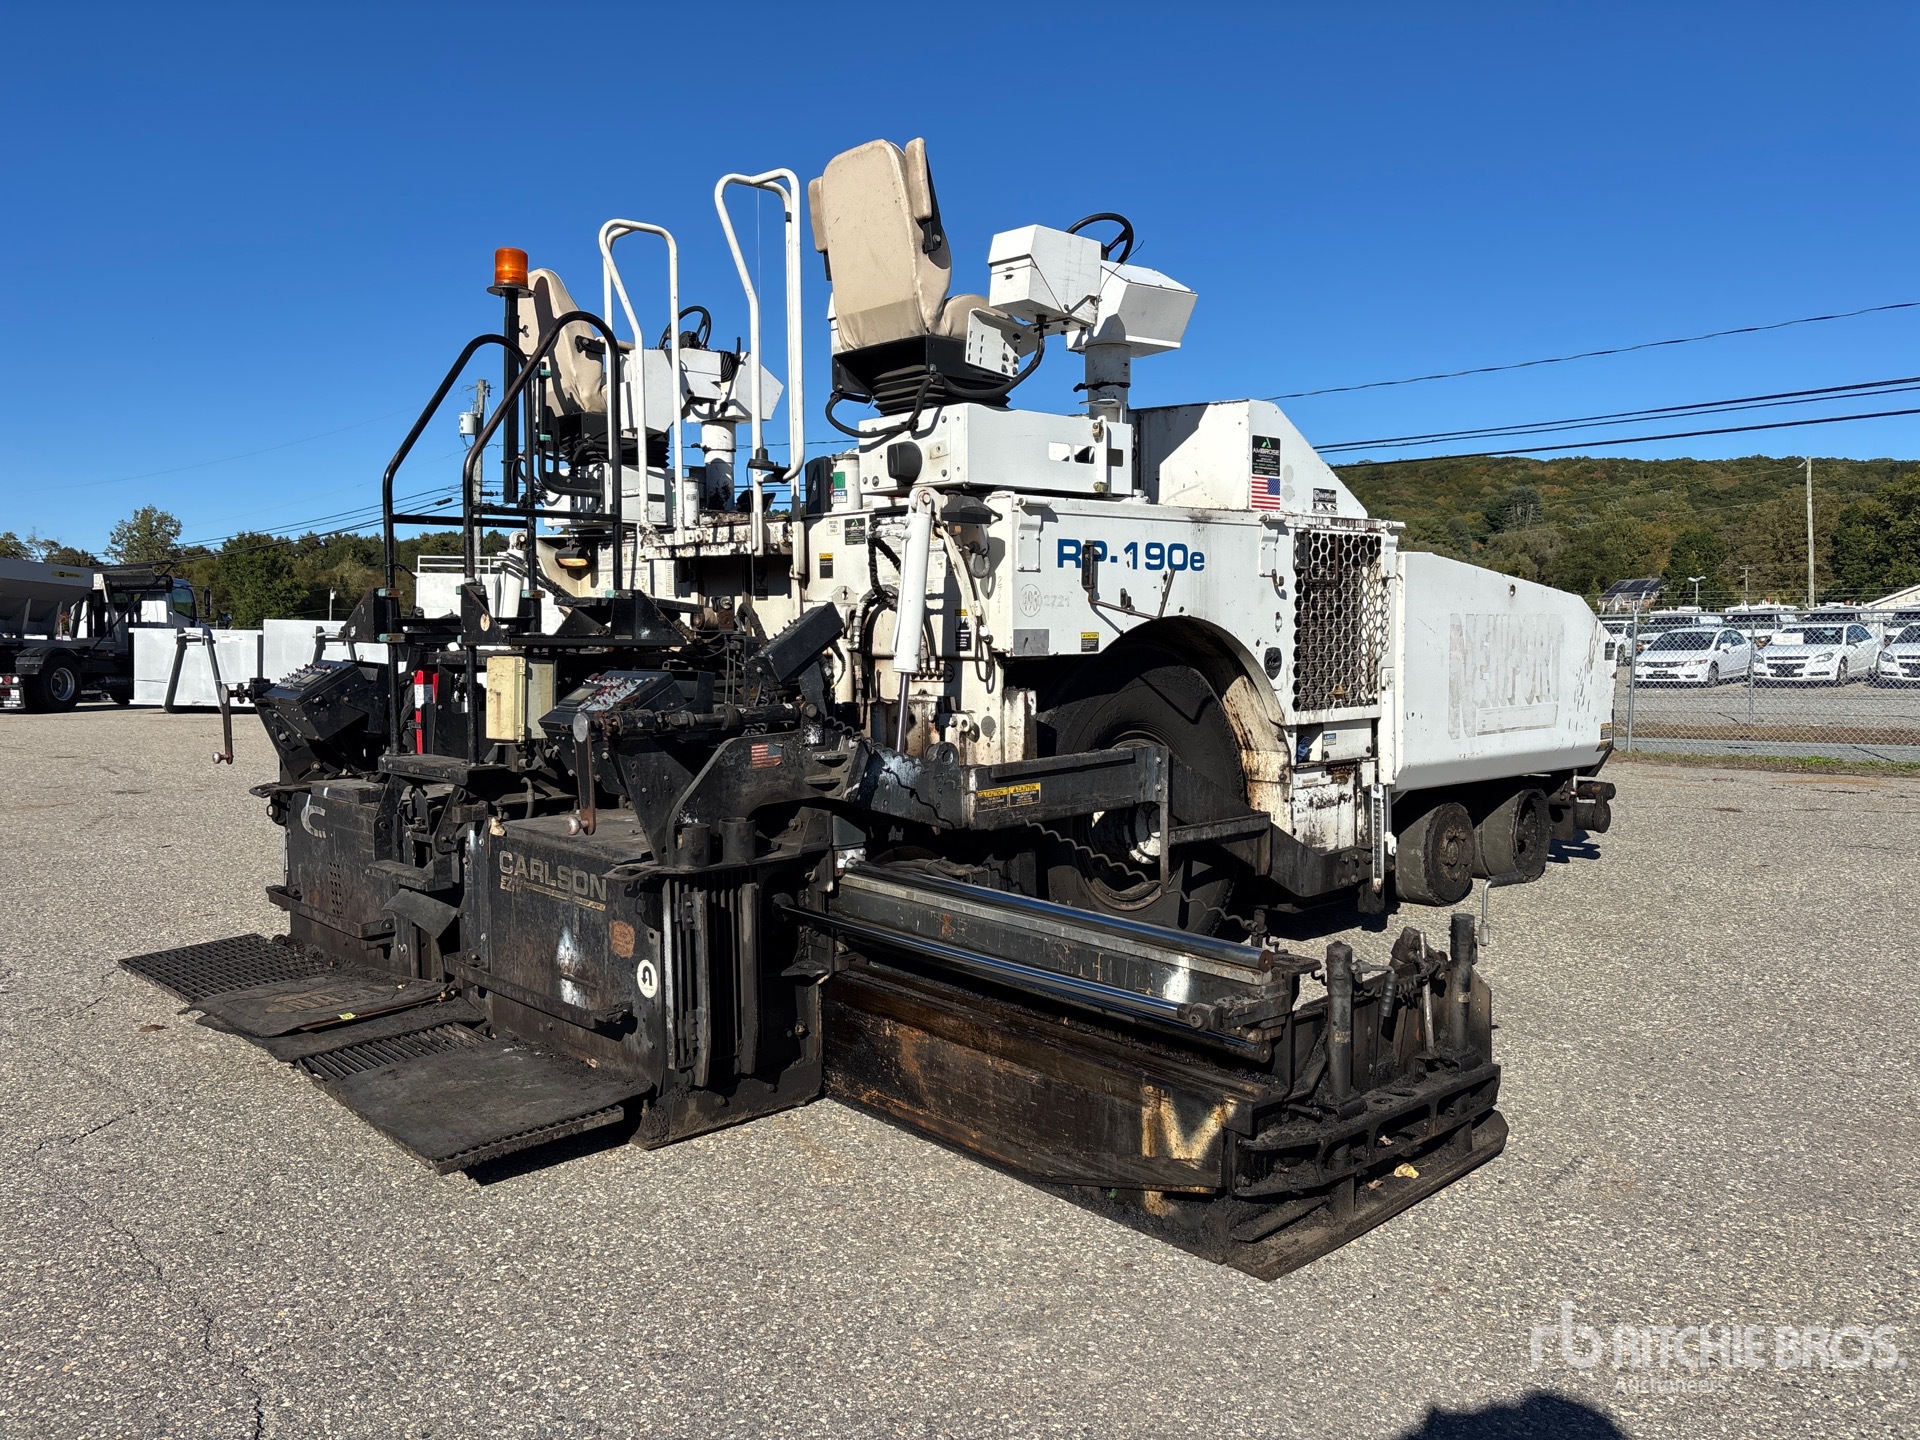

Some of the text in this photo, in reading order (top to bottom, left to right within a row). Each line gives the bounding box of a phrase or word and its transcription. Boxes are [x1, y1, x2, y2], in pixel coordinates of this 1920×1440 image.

[1252, 447, 1280, 456] AMBROSE
[1043, 594, 1071, 608] 2721
[499, 850, 607, 901] CARLSON
